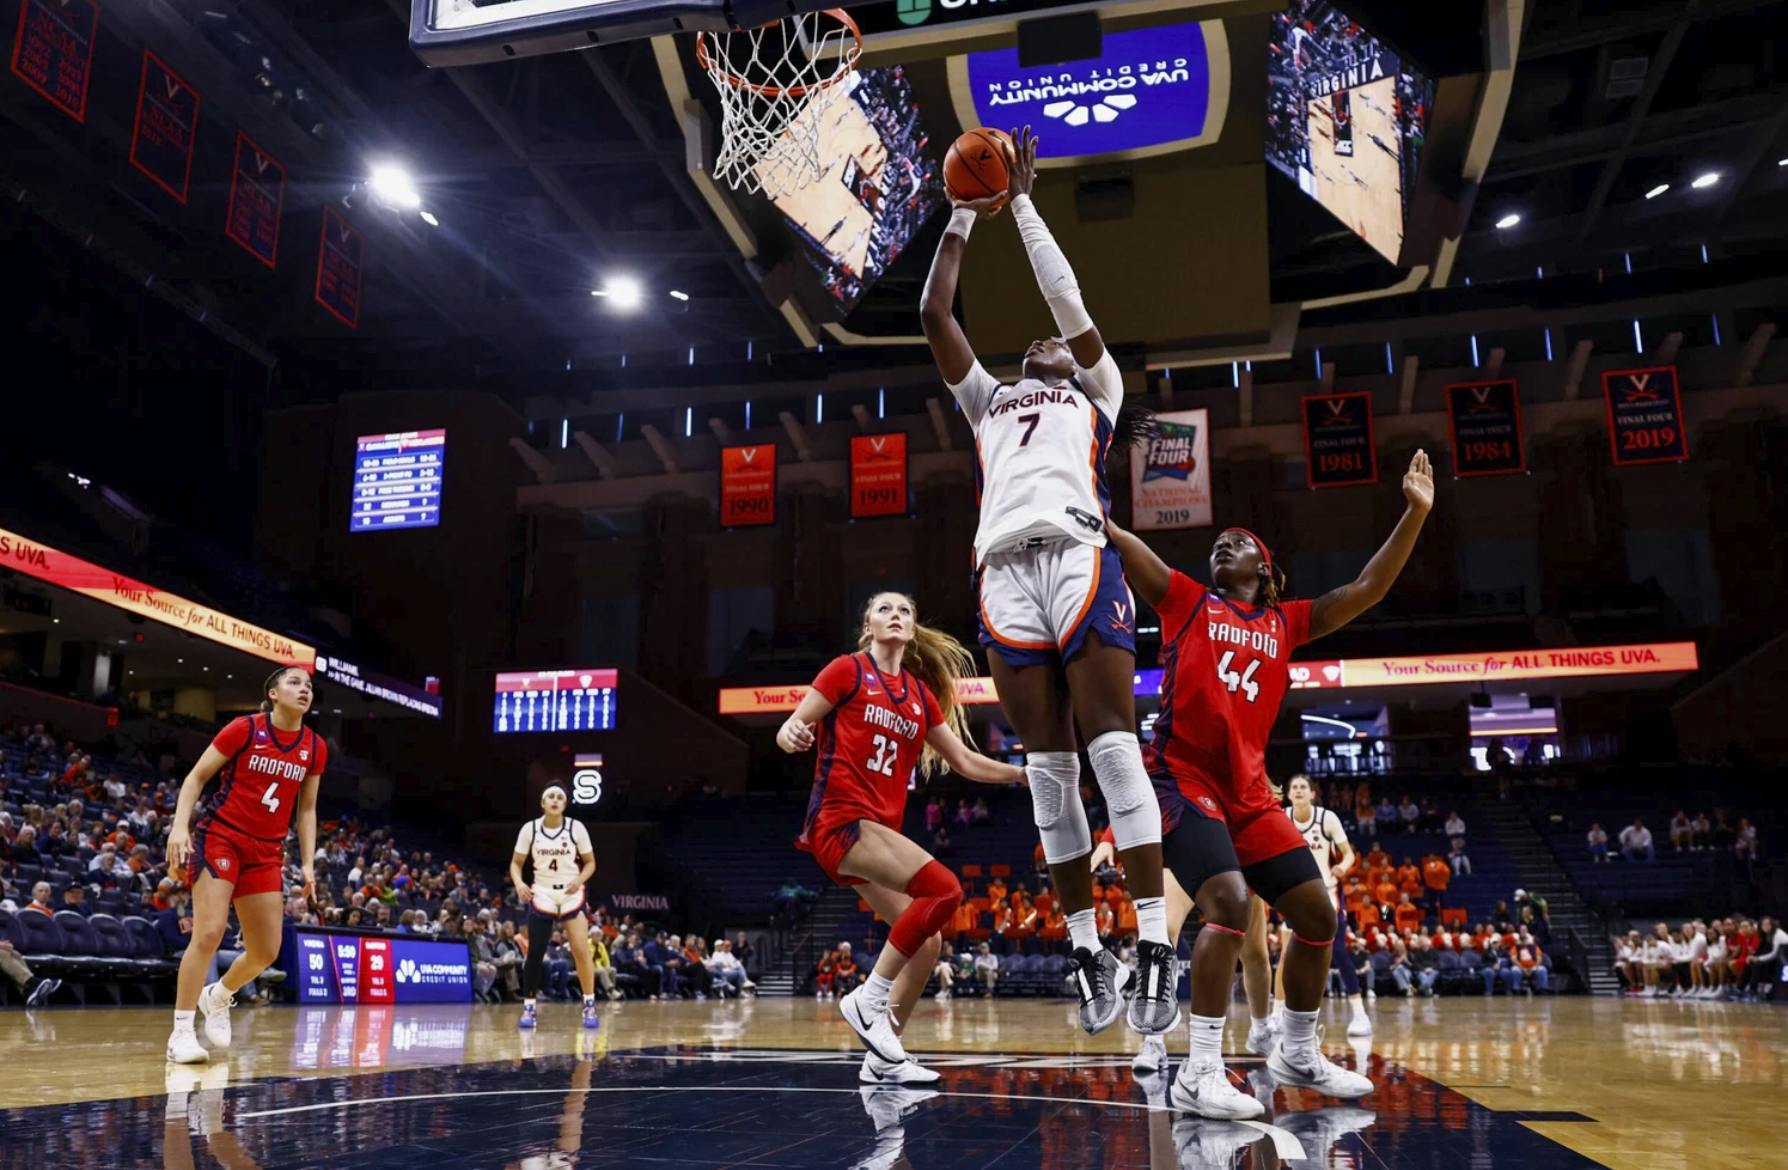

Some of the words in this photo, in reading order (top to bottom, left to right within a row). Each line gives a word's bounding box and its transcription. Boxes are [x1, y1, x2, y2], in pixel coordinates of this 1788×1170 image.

[1090, 58, 1187, 78] CREDIT
[1140, 69, 1189, 86] UVA
[989, 73, 1072, 92] UNION
[989, 76, 1137, 106] COMMUNITY
[988, 391, 1078, 418] VIRGINIA
[1617, 415, 1645, 424] FINAL
[1647, 412, 1673, 422] FOUR
[1018, 413, 1040, 447] 7
[1621, 427, 1675, 449] 2019
[1151, 437, 1191, 451] FINAL
[1463, 441, 1512, 462] 1984
[1149, 450, 1189, 465] FOUR
[1319, 452, 1363, 473] 1981
[860, 488, 897, 506] 1991
[1141, 486, 1202, 498] NATIONAL
[729, 497, 769, 516] 1990
[1136, 496, 1209, 509] CHAMPIONS
[1155, 509, 1190, 524] 2019
[15, 542, 50, 570] UVA.
[112, 575, 142, 603] Your
[145, 589, 185, 619] Source
[185, 607, 203, 626] for
[206, 615, 227, 634] ALL
[231, 623, 271, 650] THINGS
[273, 639, 296, 659] UVA.
[1382, 661, 1419, 675] Your
[1425, 658, 1478, 674] Source
[1481, 656, 1507, 676] for
[1511, 654, 1542, 669] ALL
[1549, 650, 1615, 667] THINGS
[1621, 649, 1661, 665] UVA.
[1217, 650, 1261, 702] 44
[753, 690, 785, 705] Your
[864, 704, 919, 740] RADFORD
[866, 734, 898, 776] 32
[248, 755, 307, 782] RADFORD
[261, 782, 280, 813] 4
[536, 849, 571, 857] VIRGINIA
[549, 859, 558, 872] 4
[612, 894, 669, 910] VIRGINIA
[309, 953, 324, 970] 50
[420, 964, 433, 974] UVA
[432, 964, 467, 975] COMMUNITY
[422, 976, 445, 984] CREDIT
[447, 976, 468, 984] UNION
